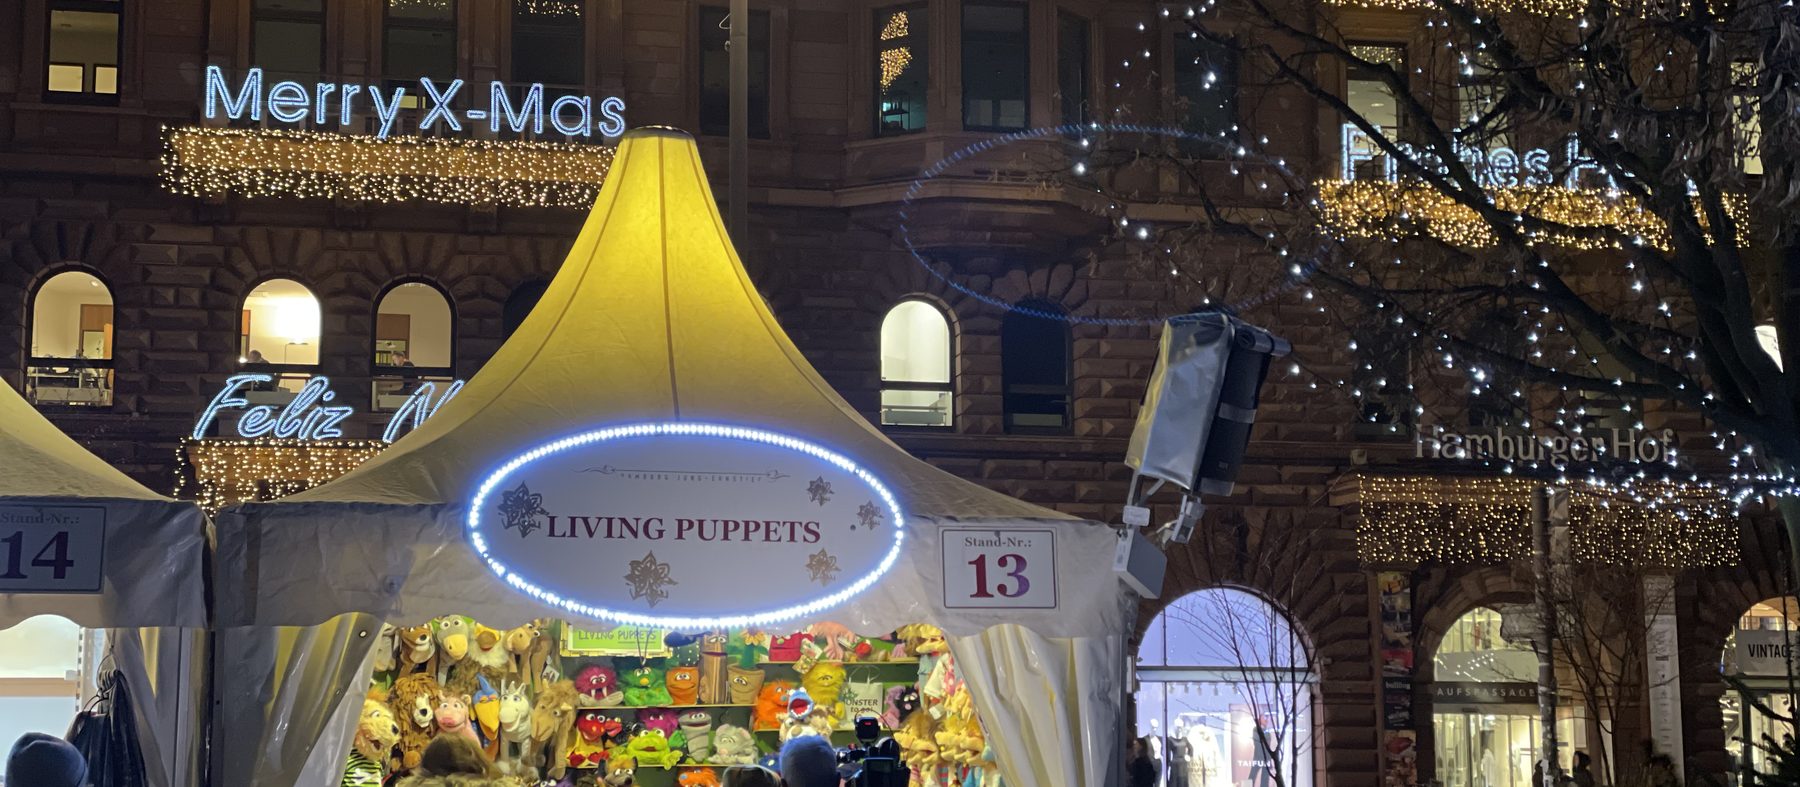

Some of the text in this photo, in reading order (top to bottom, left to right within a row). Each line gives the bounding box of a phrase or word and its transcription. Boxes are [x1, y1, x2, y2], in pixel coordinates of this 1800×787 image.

[205, 65, 626, 141] Merry X-Mas
[193, 374, 354, 441] Feliz
[1415, 423, 1676, 468] Hamburger Hof
[1, 511, 80, 525] Stand-Nr.:
[547, 515, 821, 545] LIVING PUPPETS
[0, 530, 75, 579] 14
[964, 536, 1033, 549] Stand-Nr.:
[967, 553, 1031, 599] 13
[577, 630, 657, 641] LIVING PUPPETS
[1237, 760, 1271, 768] TAIFUN
